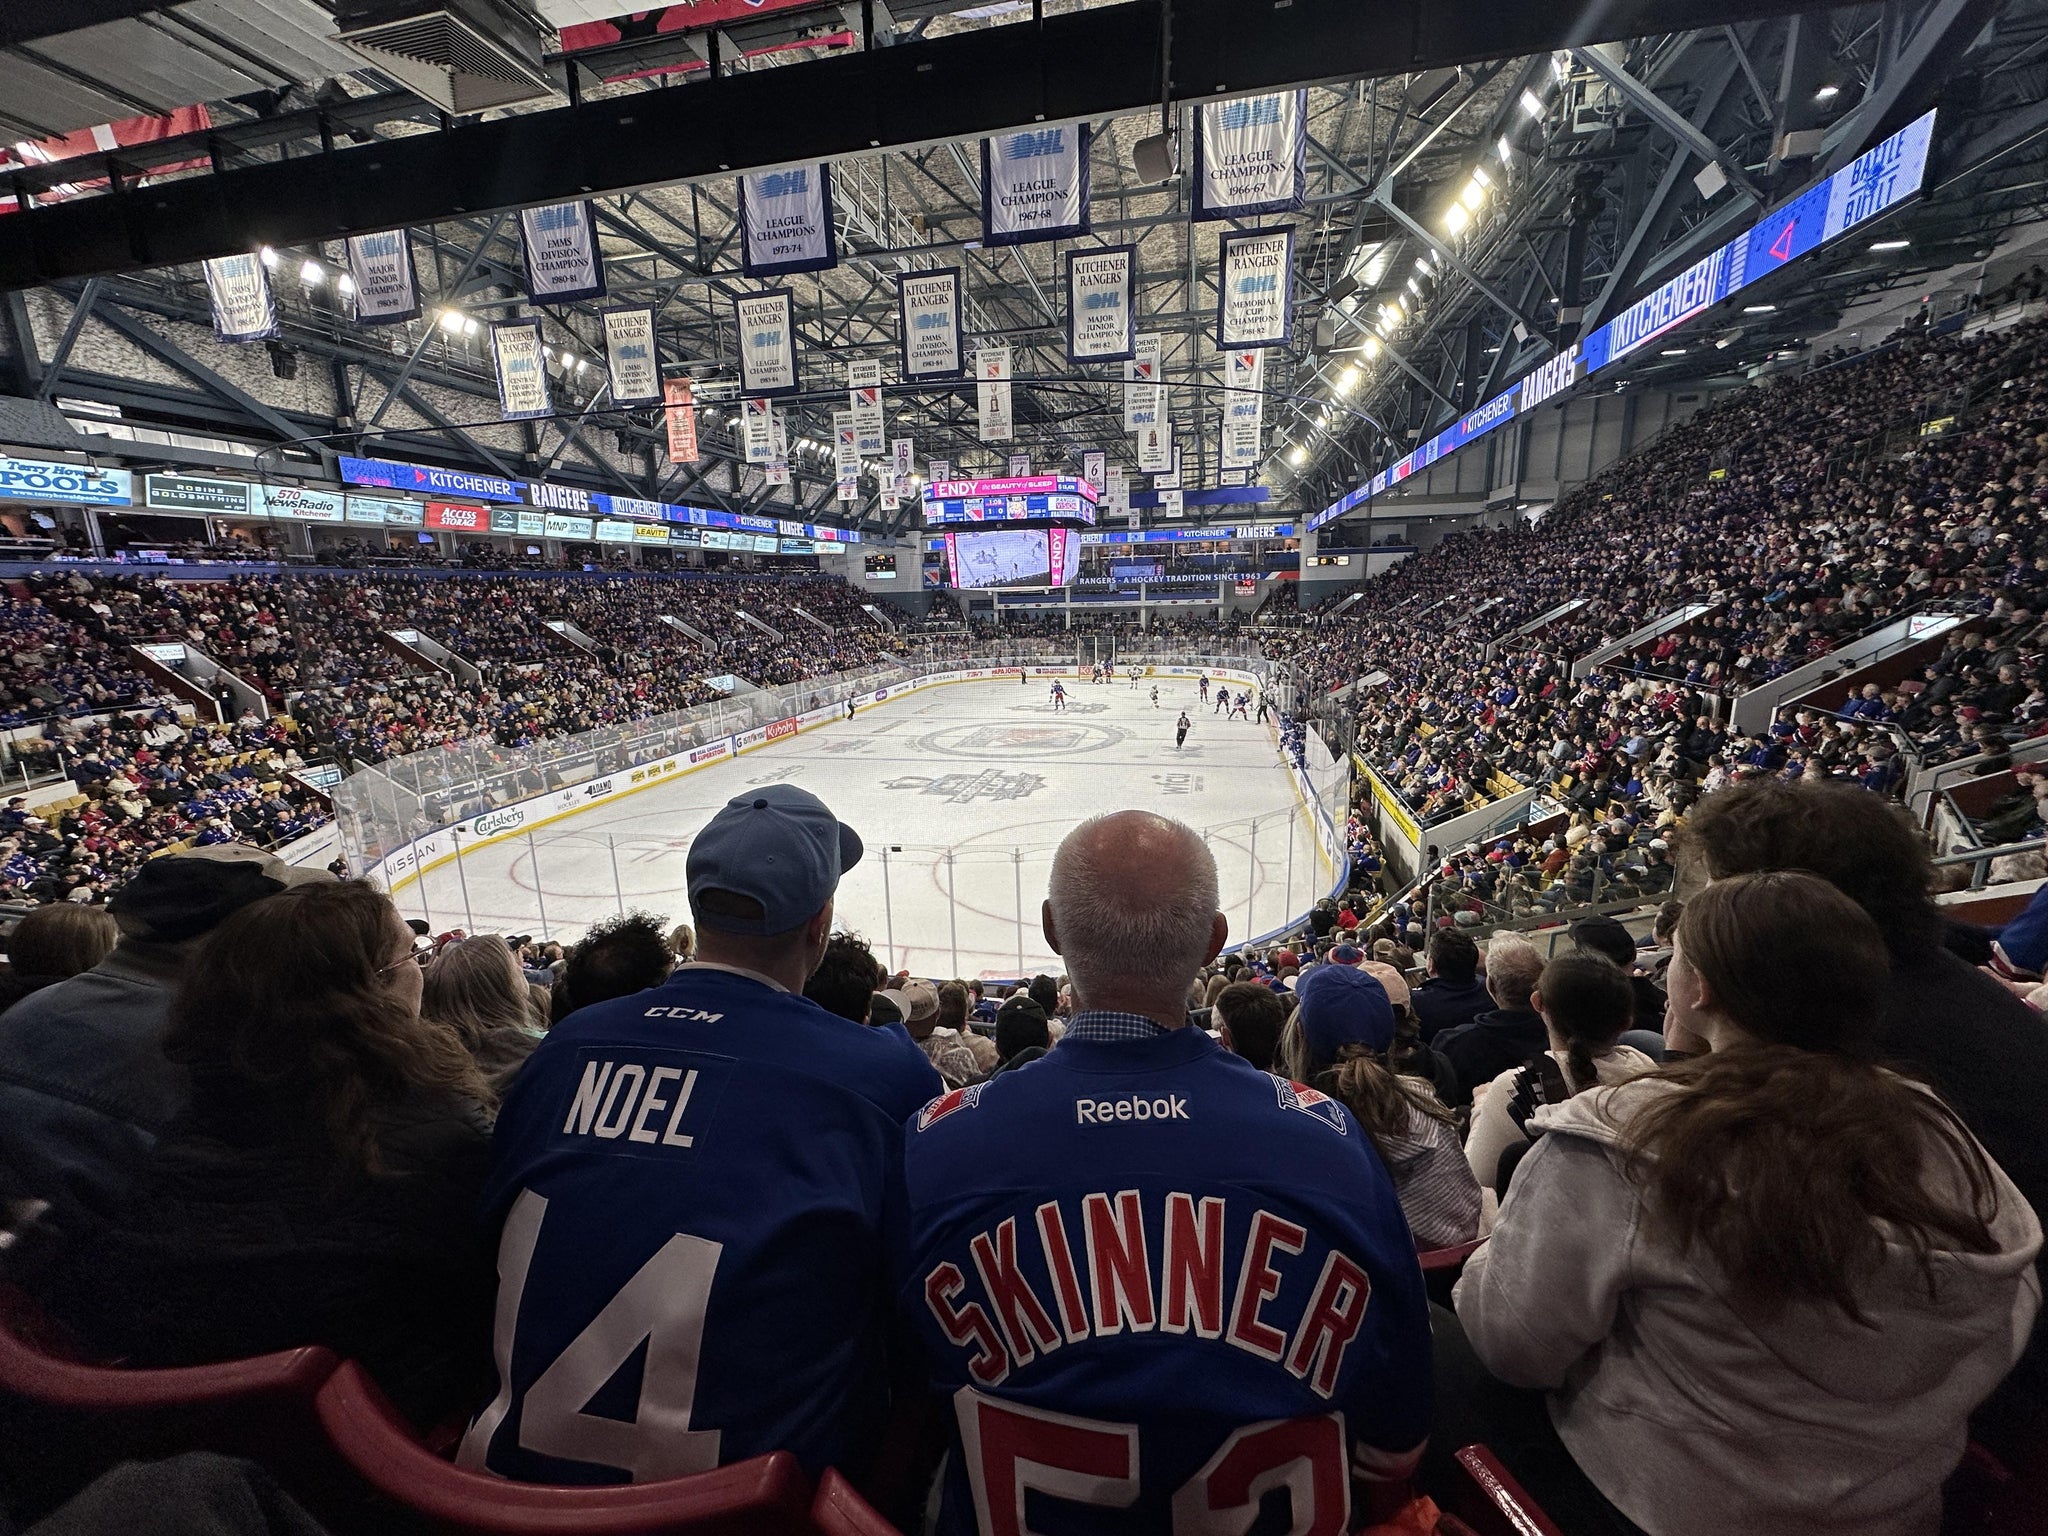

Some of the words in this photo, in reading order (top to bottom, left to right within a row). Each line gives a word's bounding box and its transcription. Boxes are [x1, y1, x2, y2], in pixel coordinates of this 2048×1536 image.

[1224, 150, 1273, 166] LEAGUE
[1211, 161, 1286, 180] CHAMPIONS
[1013, 179, 1056, 193] LEAGUE
[1229, 183, 1266, 196] 1966-67
[1001, 189, 1068, 207] CHAMPIONS
[766, 215, 805, 228] LEAGUE
[1018, 209, 1052, 222] 1967-68
[757, 226, 816, 241] CHAMPIONS
[547, 237, 572, 249] EMMS
[772, 243, 802, 255] 1973-74
[1229, 240, 1284, 257] KITCHENER
[541, 248, 580, 260] DIVISION
[536, 258, 589, 271] CHAMPIONS
[1075, 259, 1126, 275] KITCHENER
[1234, 254, 1278, 270] RANGERS
[368, 264, 396, 275] MAJOR
[369, 274, 398, 286] JUNIOR
[1080, 272, 1122, 287] RANGERS
[361, 283, 407, 296] CHAMPIONS
[906, 280, 952, 297] KITCHENER
[911, 293, 949, 308] RANGERS
[1232, 297, 1276, 308] MEMORIAL
[1616, 260, 1709, 351] KITCHENER
[742, 301, 785, 316] KITCHENER
[1245, 308, 1263, 316] CUP
[608, 316, 648, 329] KITCHENER
[747, 313, 782, 327] RANGERS
[1087, 315, 1114, 323] MAJOR
[1229, 314, 1279, 326] CHAMPIONS
[613, 327, 646, 339] RANGERS
[1086, 323, 1115, 333] JUNIOR
[498, 331, 535, 344] KITCHENER
[1078, 330, 1123, 340] CHAMPIONS
[503, 343, 533, 353] RANGERS
[916, 341, 948, 350] DIVISION
[1135, 338, 1159, 347] CHENER
[911, 348, 953, 358] CHAMPIONS
[755, 359, 780, 367] LEAGUE
[750, 365, 787, 375] CHAMPIONS
[1520, 345, 1578, 413] RANGERS
[1467, 393, 1509, 434] KITCHENER
[897, 444, 909, 458] 16
[7, 461, 50, 474] Terry
[1091, 463, 1098, 476] 6
[0, 471, 119, 494] POOLS
[176, 484, 224, 494] ROBINS
[429, 471, 512, 496] KITCHENER
[938, 482, 979, 497] ENDY
[991, 482, 1022, 490] BEAUTY
[1028, 480, 1053, 488] SLEEP
[151, 490, 246, 504] GOLDSMITHING
[277, 489, 301, 500] 570
[530, 482, 590, 512] RANGERS
[263, 496, 334, 511] NewsRadio
[616, 497, 658, 516] KITCHENER
[293, 508, 332, 519] Kitchener
[440, 507, 478, 520] ACCESS
[440, 517, 477, 527] STORAGE
[547, 521, 568, 532] MNP
[740, 516, 774, 529] KITCHENER
[779, 519, 805, 537] RANGERS
[636, 527, 667, 537] LEAVITT
[1183, 529, 1226, 537] KITCHENER
[1236, 526, 1275, 539] RANGERS
[947, 538, 955, 571] ENDY
[1053, 532, 1062, 569] ENDY
[1079, 577, 1117, 585] RANGERS
[1123, 576, 1129, 584] A
[1131, 575, 1164, 583] HOCKEY
[1166, 574, 1212, 582] TRADITION
[1213, 573, 1238, 581] SINCE
[1240, 572, 1261, 580] 1963
[767, 720, 794, 738] Kubota
[697, 748, 726, 762] SUPERSTORE
[592, 780, 612, 794] ADAMO
[474, 807, 524, 836] Carlsberg
[643, 1006, 725, 1024] CCM
[563, 1060, 699, 1149] NOEL
[1076, 1093, 1190, 1124] Reebok
[924, 1189, 1371, 1400] SKINNER
[455, 1187, 723, 1484] 14
